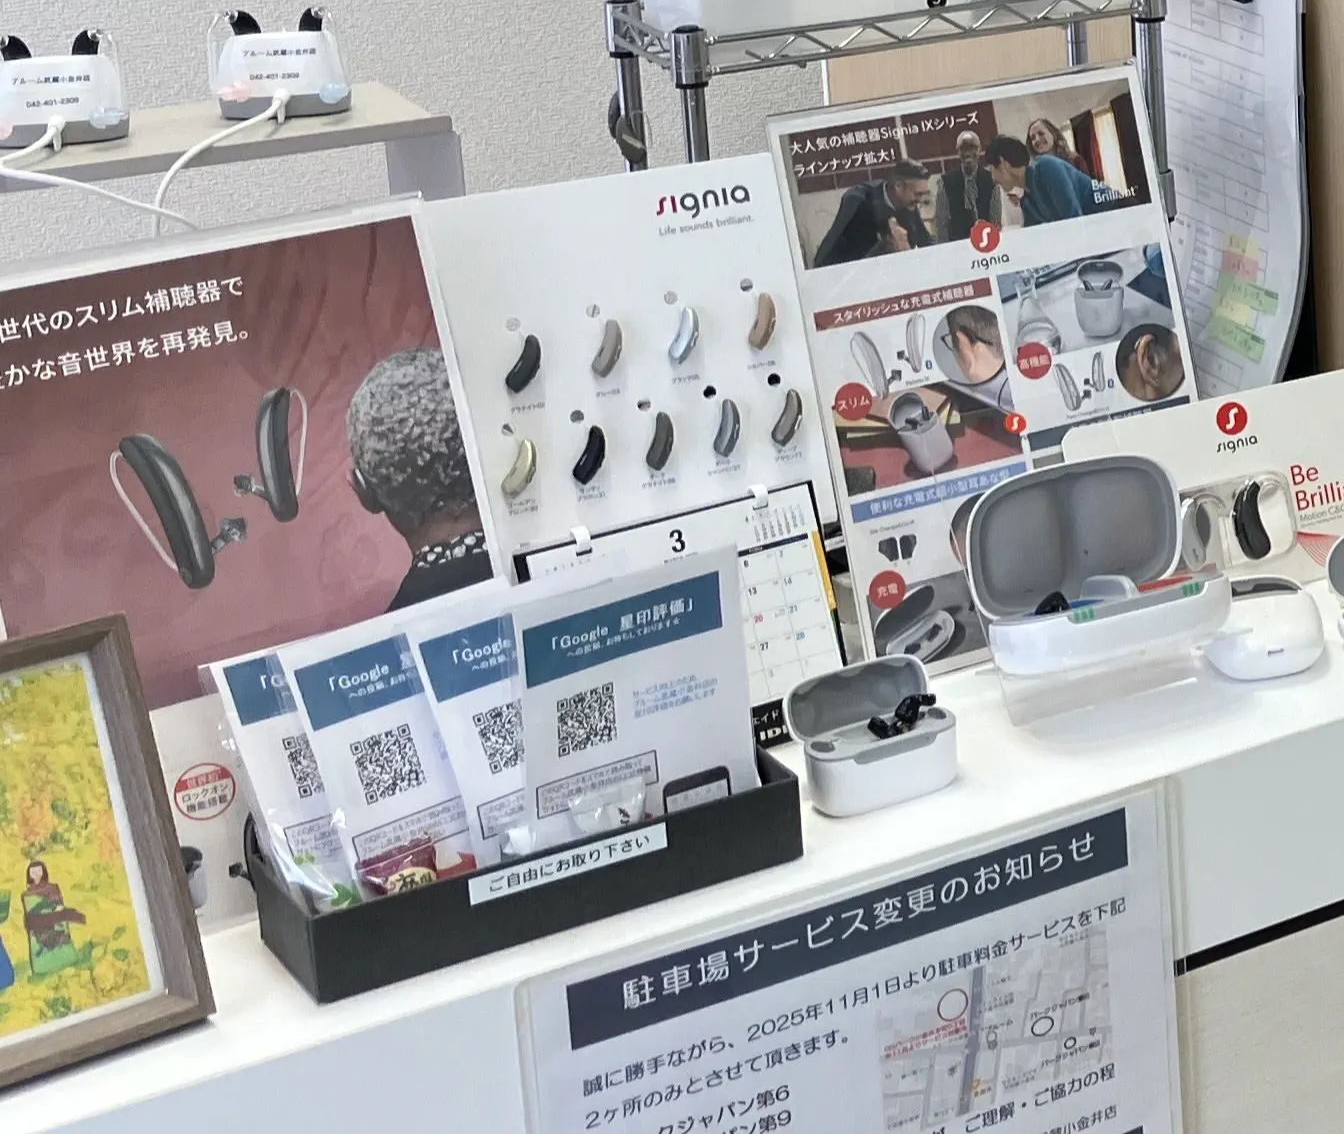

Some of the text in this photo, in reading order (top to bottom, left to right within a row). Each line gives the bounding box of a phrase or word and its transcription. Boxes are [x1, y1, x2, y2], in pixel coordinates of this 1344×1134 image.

[656, 185, 751, 219] signia
[659, 225, 677, 236] Life
[680, 219, 714, 233] sounds
[971, 253, 1010, 270] signia
[834, 284, 975, 324] スタイリッシュな充電式補聴器
[0, 320, 249, 389] かな音世界を再発見。
[837, 398, 871, 411] スリム
[1216, 435, 1258, 453] signia
[1290, 464, 1319, 486] Be
[669, 529, 686, 553] 3
[748, 577, 793, 596] 13 14
[877, 583, 899, 598] 充電
[552, 597, 693, 651] 「Google 星印評価」
[754, 614, 764, 623] 20
[759, 642, 769, 651] 27
[328, 664, 389, 693] 「Google
[182, 784, 228, 803] ロックオン
[489, 835, 650, 892] ご自由にお取り下さい
[622, 832, 1096, 1012] 駐車場サービス変更のお知らせ
[965, 1062, 1116, 1134] ご理解・ご協力の程
